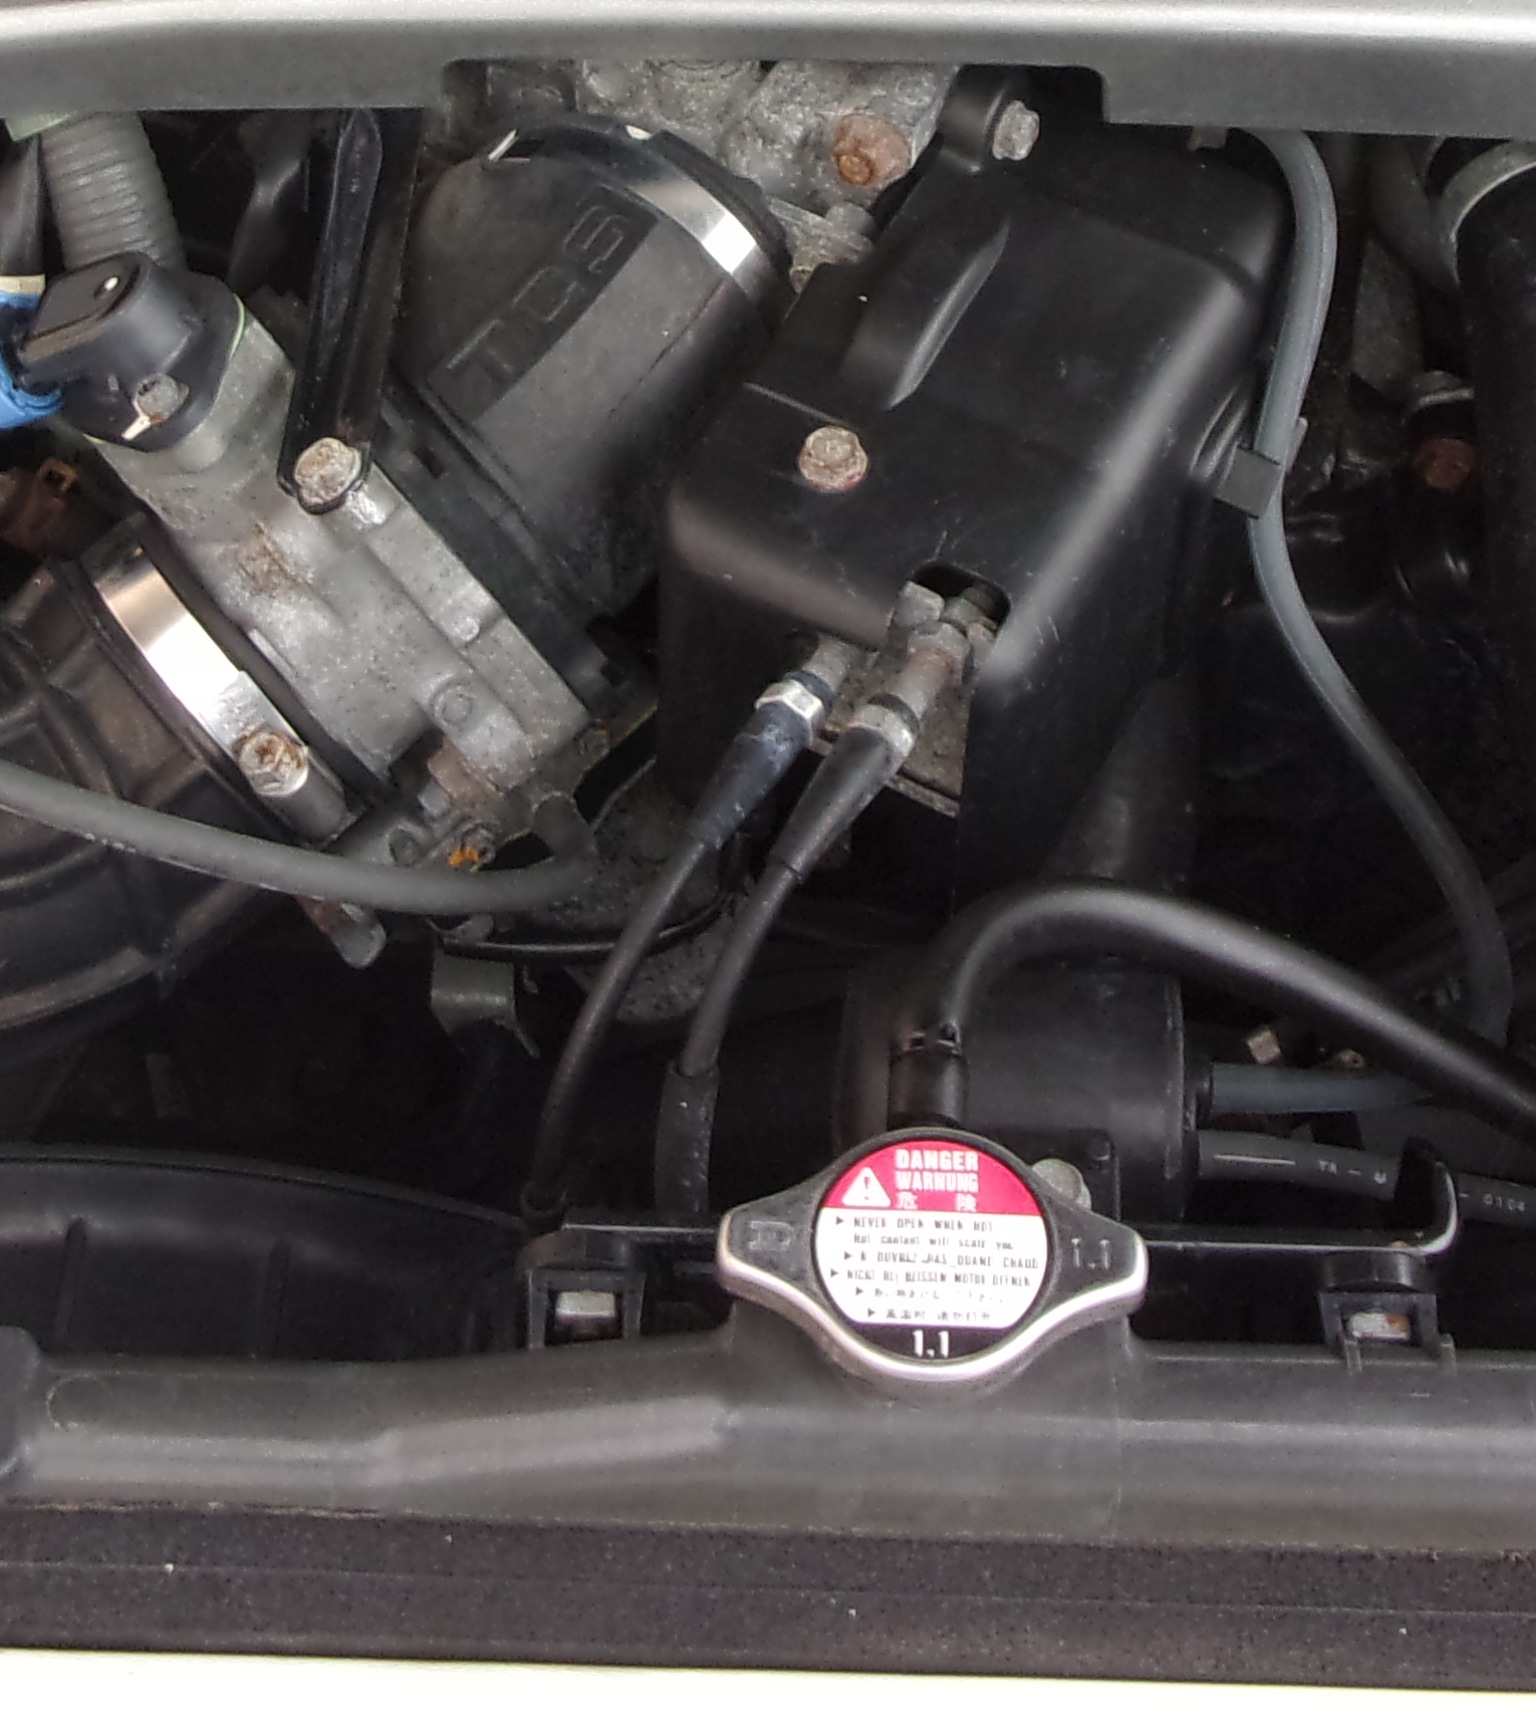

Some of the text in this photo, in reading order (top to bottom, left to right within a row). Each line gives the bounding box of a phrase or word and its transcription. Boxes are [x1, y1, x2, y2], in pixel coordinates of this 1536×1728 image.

[895, 1149, 979, 1172] DANGER
[895, 1171, 979, 1192] WARNUNG
[854, 1217, 887, 1228] NEVER
[897, 1218, 924, 1229] OPEN
[1070, 1237, 1111, 1271] 1.1
[911, 1330, 950, 1358] 1.1
